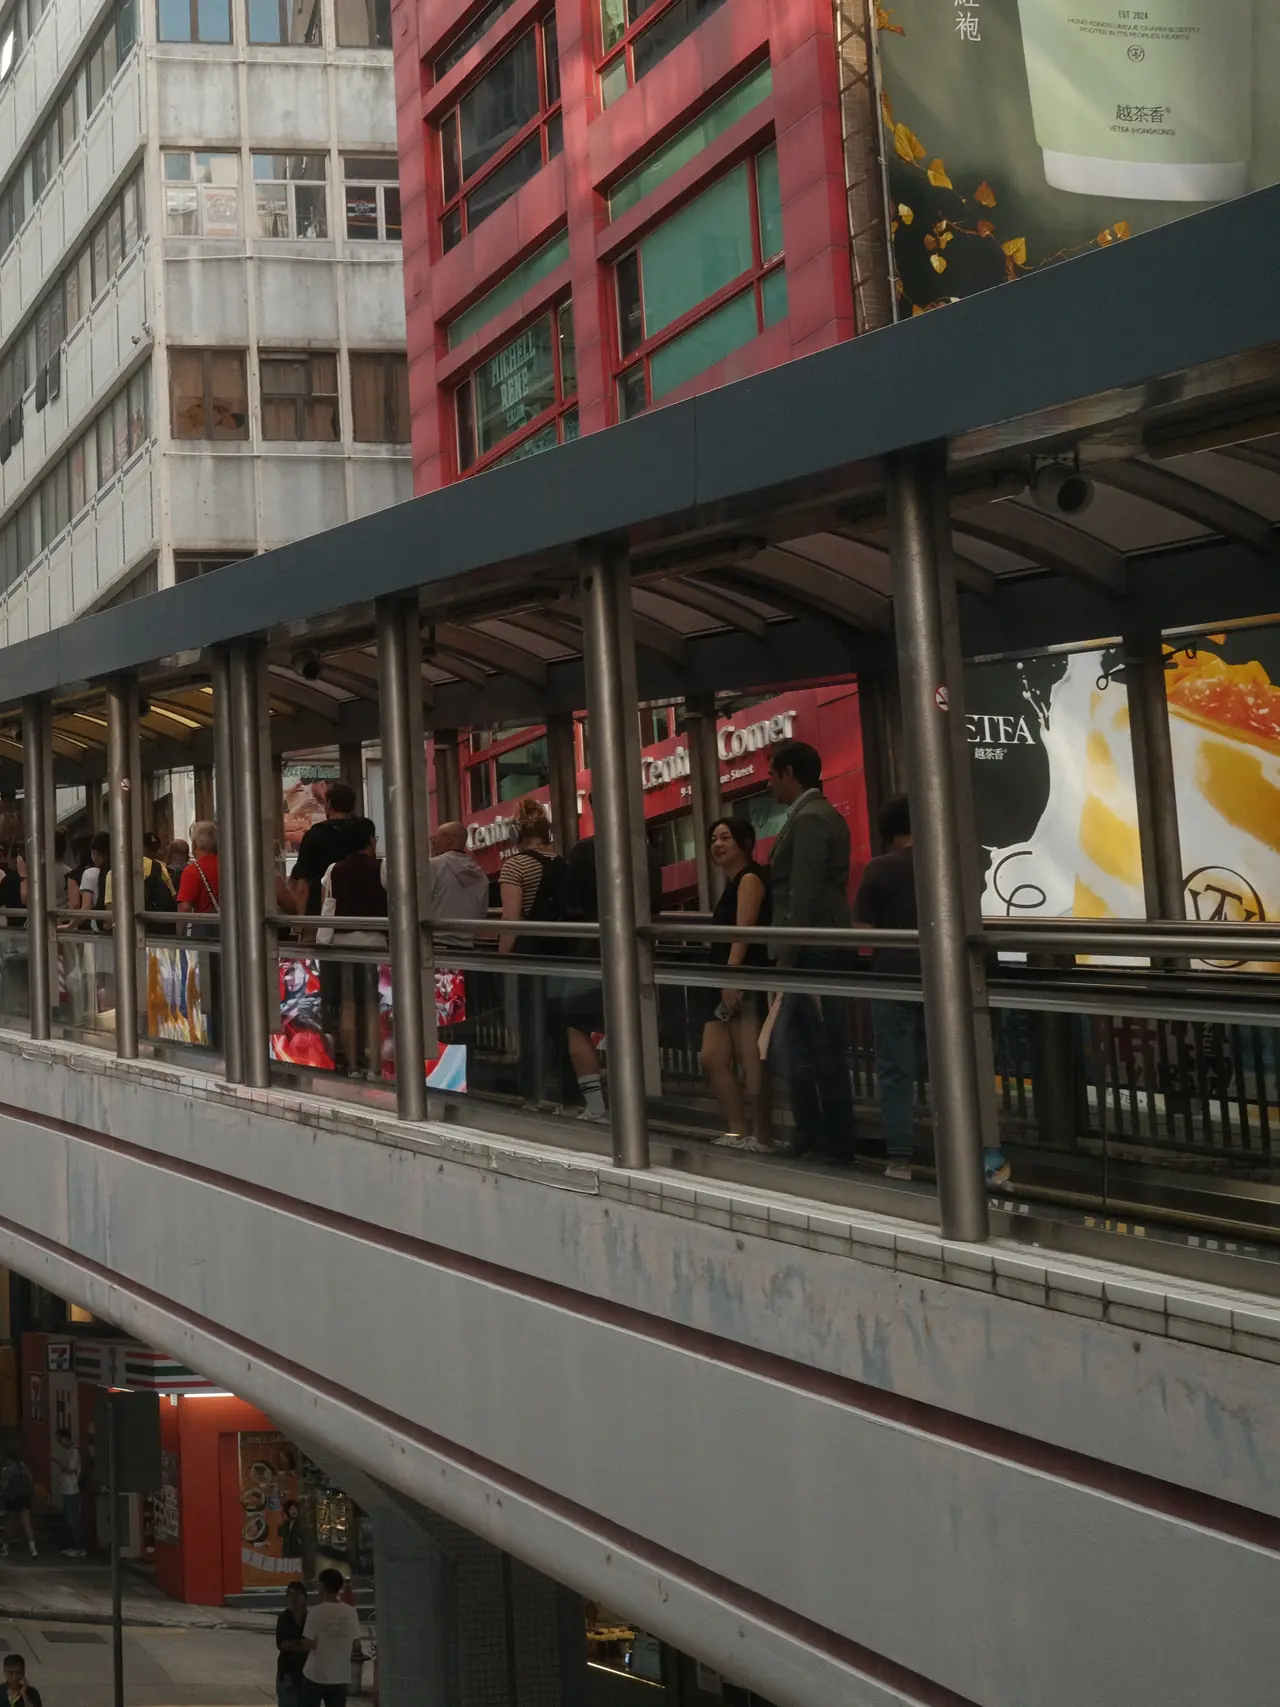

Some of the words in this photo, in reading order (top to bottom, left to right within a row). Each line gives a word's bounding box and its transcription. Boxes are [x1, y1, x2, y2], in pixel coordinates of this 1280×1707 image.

[1133, 11, 1149, 20] 2024
[1115, 103, 1165, 124] 越茶香
[717, 710, 797, 761] Corner
[965, 714, 1036, 745] ETEA
[731, 764, 754, 780] Street
